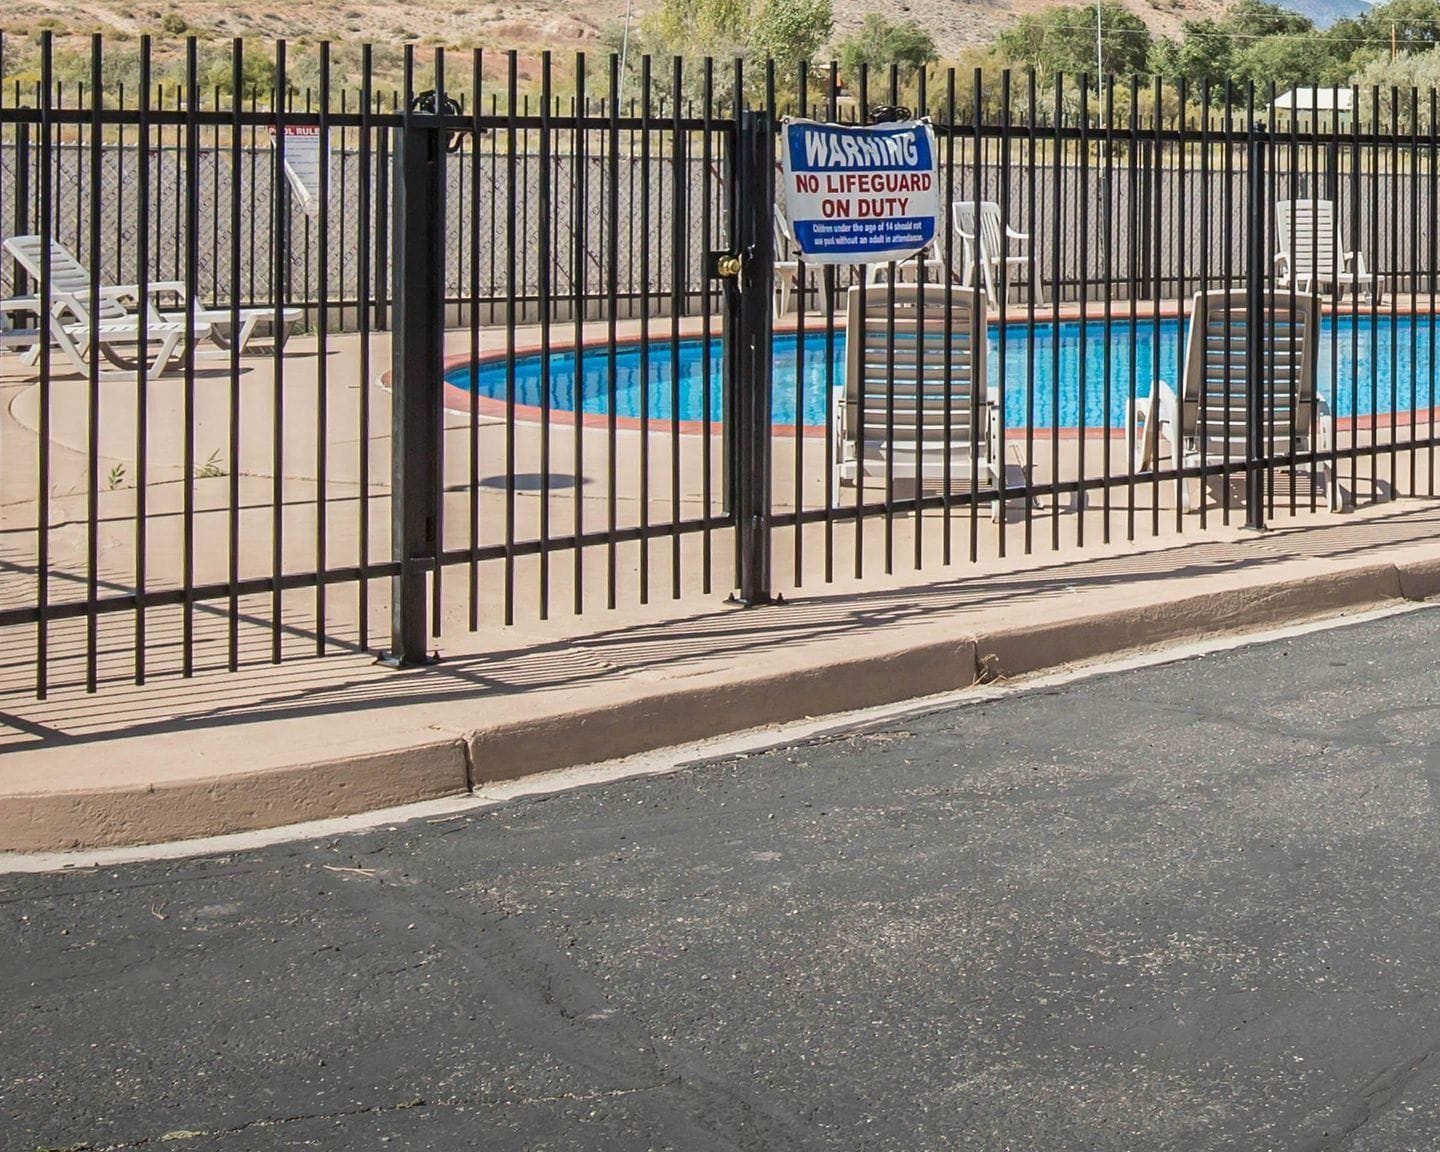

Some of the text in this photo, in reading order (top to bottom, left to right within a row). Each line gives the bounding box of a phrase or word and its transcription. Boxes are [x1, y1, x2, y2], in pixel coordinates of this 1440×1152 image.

[268, 127, 320, 135] PL RULE
[804, 130, 918, 168] WARNING
[795, 173, 931, 193] NO LIFEGUARD
[821, 198, 908, 218] ON DUTY
[833, 223, 851, 233] under
[852, 222, 863, 232] the
[864, 223, 876, 234] age
[877, 221, 884, 231] of
[886, 221, 893, 231] 14
[835, 235, 858, 245] without
